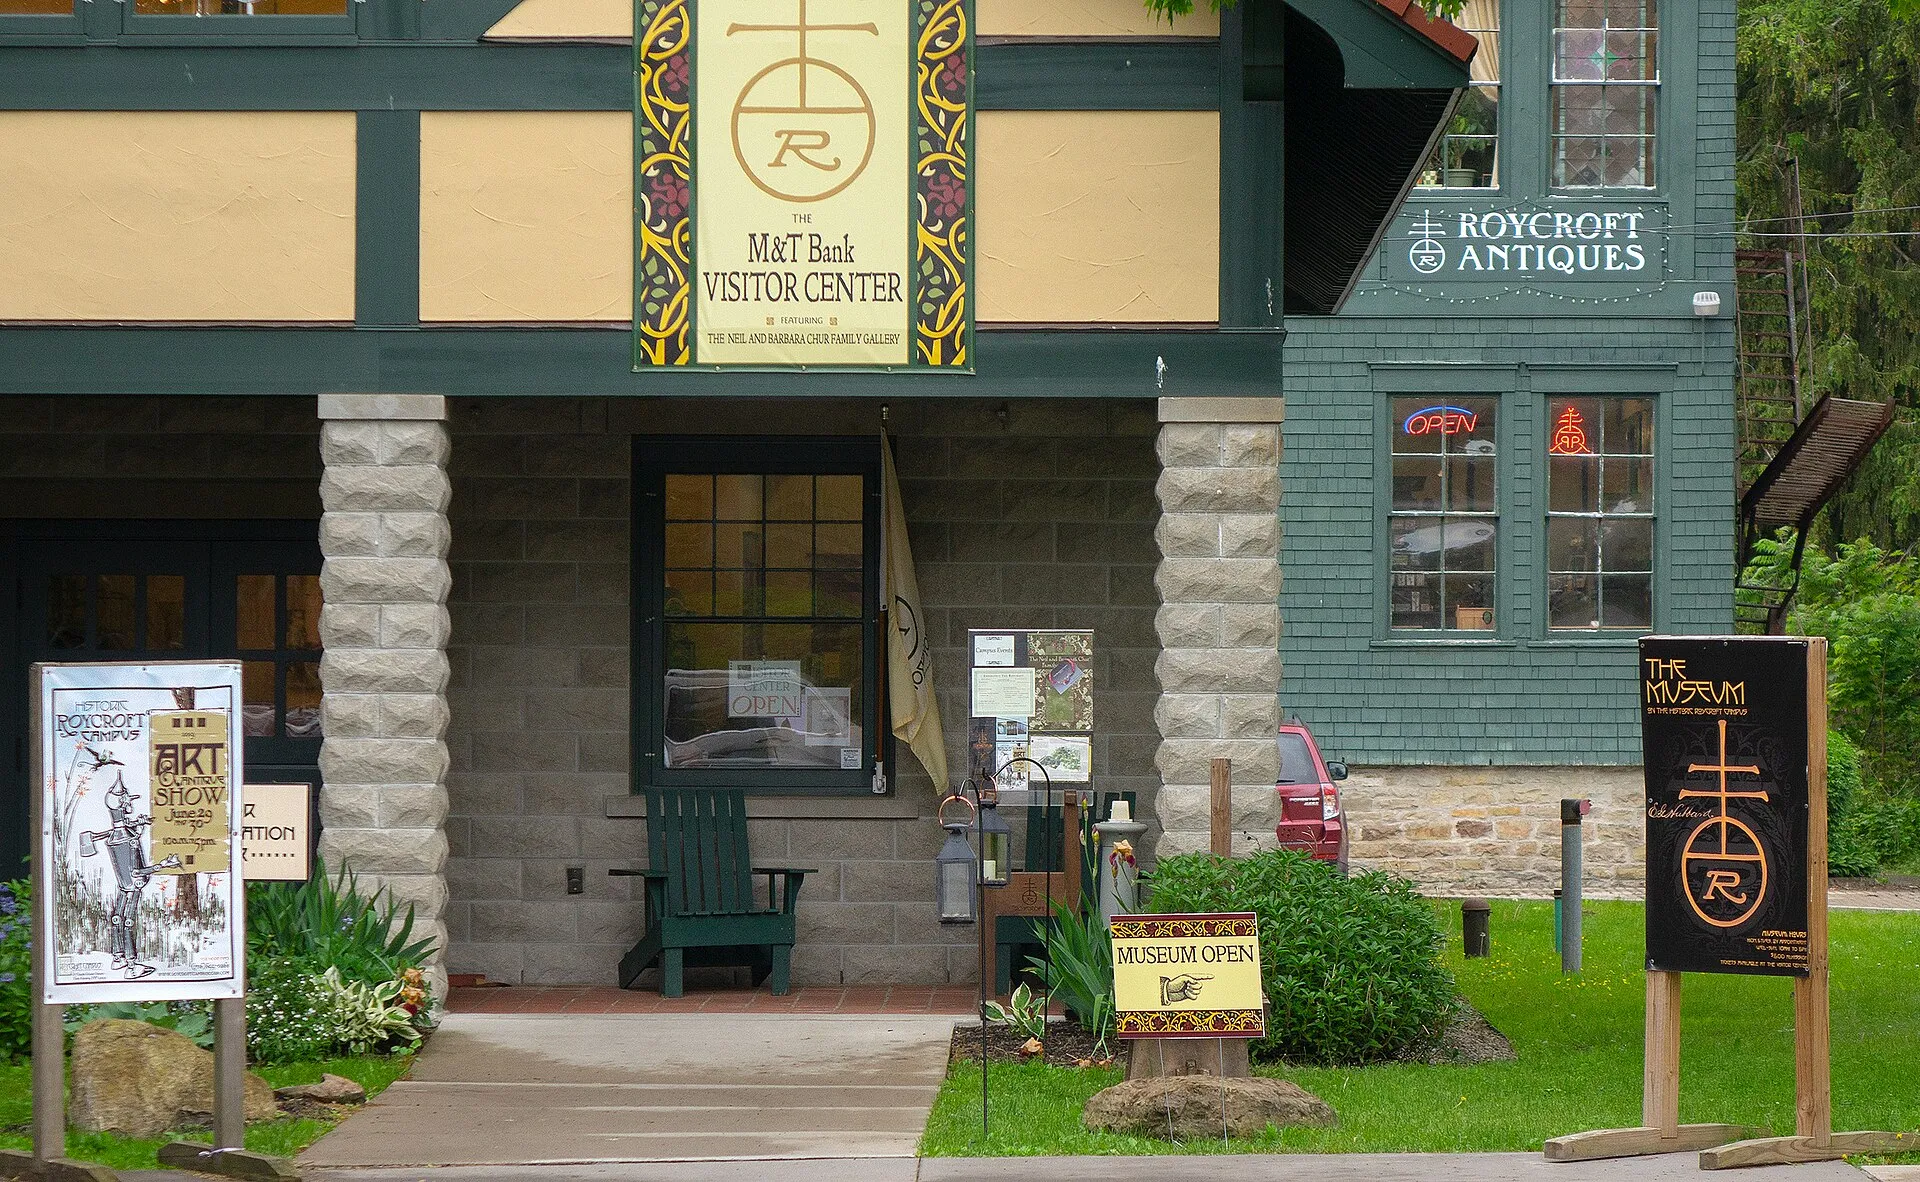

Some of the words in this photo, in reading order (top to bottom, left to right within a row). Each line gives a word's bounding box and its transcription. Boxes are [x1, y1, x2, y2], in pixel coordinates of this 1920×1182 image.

[792, 213, 812, 223] THE
[1458, 211, 1645, 240] ROYCROFT
[748, 232, 803, 263] M&T
[808, 233, 855, 263] Bank
[1457, 244, 1646, 275] ANTIQUES
[703, 271, 800, 303] VISITOR
[804, 271, 903, 303] CENTER
[780, 316, 823, 325] FEATURING
[708, 333, 725, 344] THE
[727, 333, 747, 344] NEIL
[748, 333, 767, 344] AND
[768, 333, 805, 345] BARBARA
[806, 333, 829, 345] CHUR
[831, 333, 862, 345] FAMILY
[863, 333, 901, 345] GALLERY
[1408, 414, 1477, 435] OPEN
[976, 647, 996, 655] Campus
[1645, 658, 1687, 680] THE
[744, 680, 790, 692] CENTER
[1646, 679, 1745, 705] MUSEUM
[732, 695, 798, 715] OPEN
[1657, 707, 1669, 715] THE
[1669, 707, 1694, 715] HISTORIC
[1694, 707, 1723, 716] ROYCROFT
[1723, 708, 1748, 716] CAMPUS
[55, 713, 146, 738] ROYCROFT
[80, 729, 140, 742] CAMPUS
[154, 743, 224, 776] ART
[180, 775, 225, 785] ANTIQUE
[154, 786, 225, 806] SHOW
[164, 809, 195, 822] June
[197, 808, 213, 824] 29
[188, 819, 204, 837] 30
[242, 826, 295, 841] ATION
[1761, 930, 1788, 938] MUSEUM
[1788, 931, 1807, 939] HOURS
[1117, 946, 1198, 964] MUSEUM
[1201, 945, 1254, 963] OPEN
